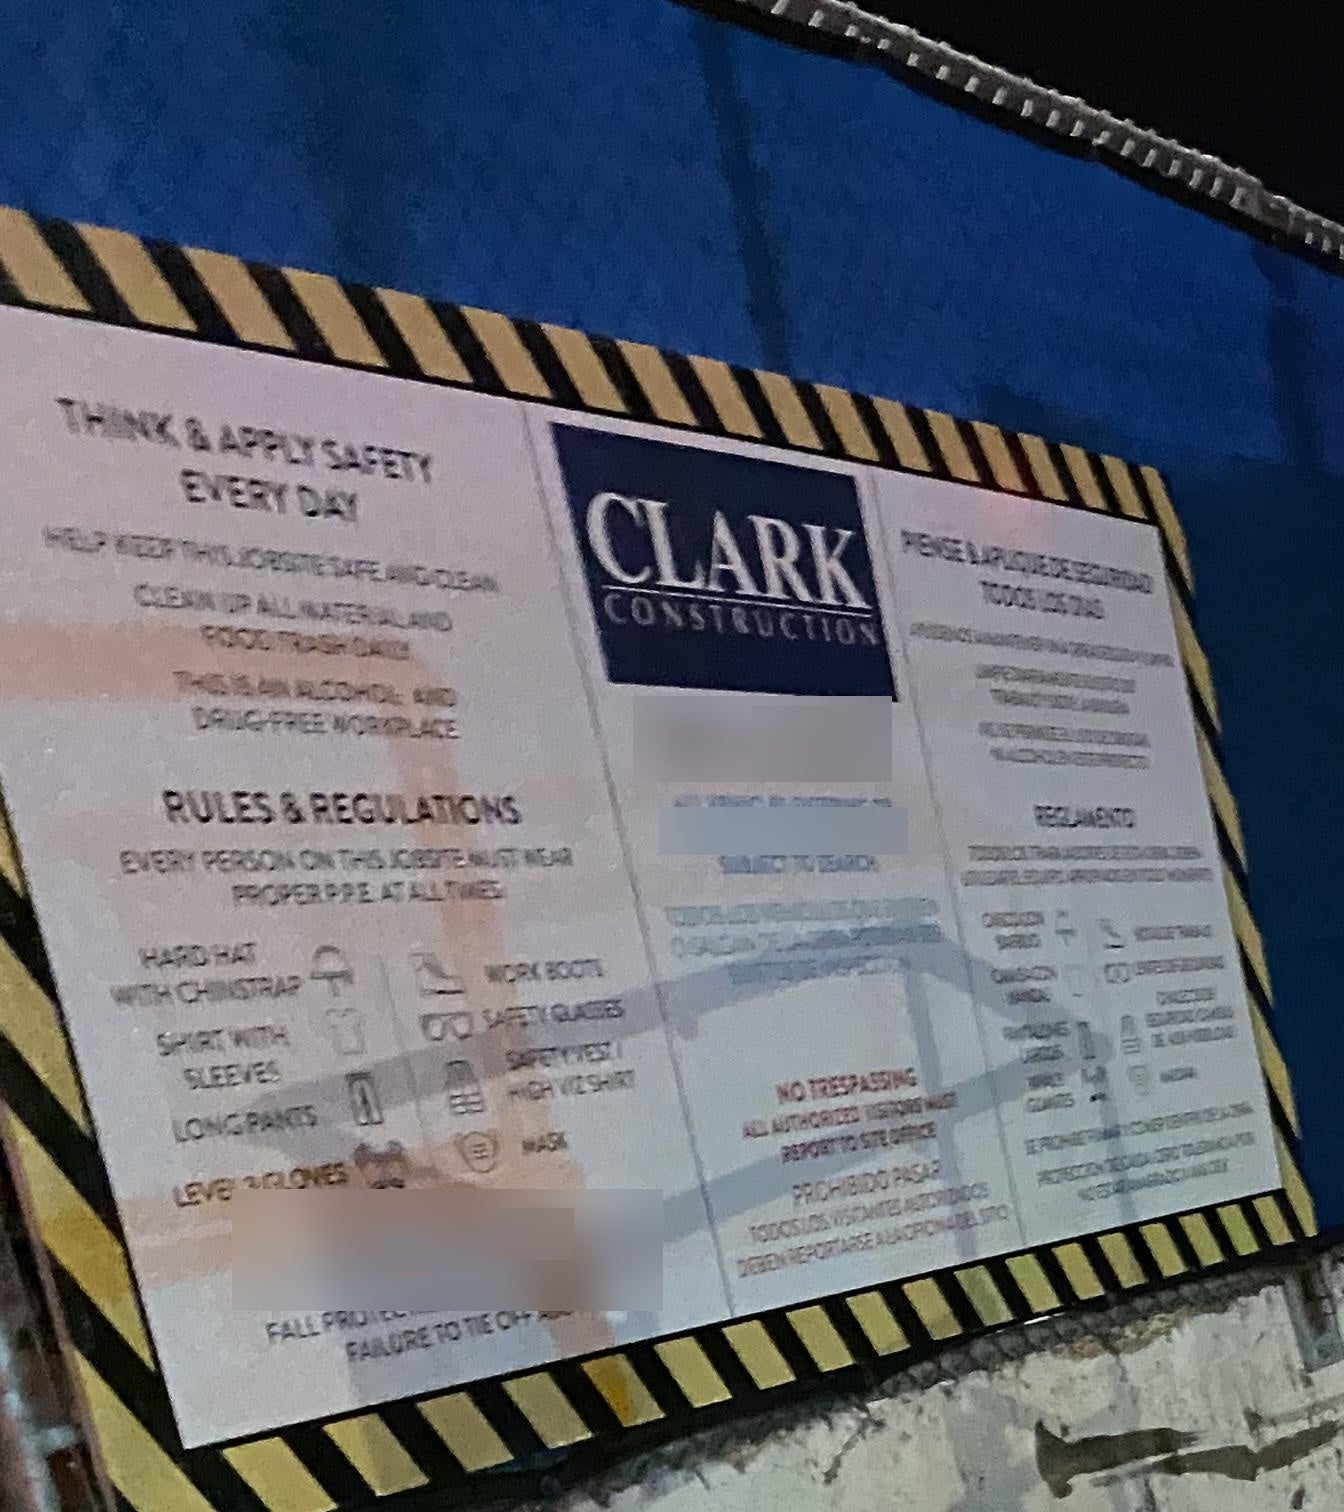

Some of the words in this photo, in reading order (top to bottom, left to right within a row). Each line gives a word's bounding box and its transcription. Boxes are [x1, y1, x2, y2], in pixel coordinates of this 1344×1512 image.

[57, 396, 181, 450] THINK
[185, 416, 211, 452] &
[219, 423, 315, 466] APPLY
[321, 438, 433, 483] SAFETY
[181, 467, 288, 514] EVERY
[298, 483, 359, 522] DAY
[587, 491, 873, 611] CLARK
[602, 592, 880, 647] CONSTRUCTION
[161, 788, 273, 825] RULES
[279, 790, 306, 825] &
[310, 792, 525, 825] REGULATIONS
[119, 848, 196, 876] EVERY
[201, 848, 296, 874] PERSON
[138, 944, 208, 969] HARD
[210, 942, 257, 967] HAT
[184, 1059, 281, 1091] SLEEVES
[776, 1081, 807, 1104] NO
[808, 1066, 918, 1100] TRESPASSING
[172, 1111, 244, 1143] LONG
